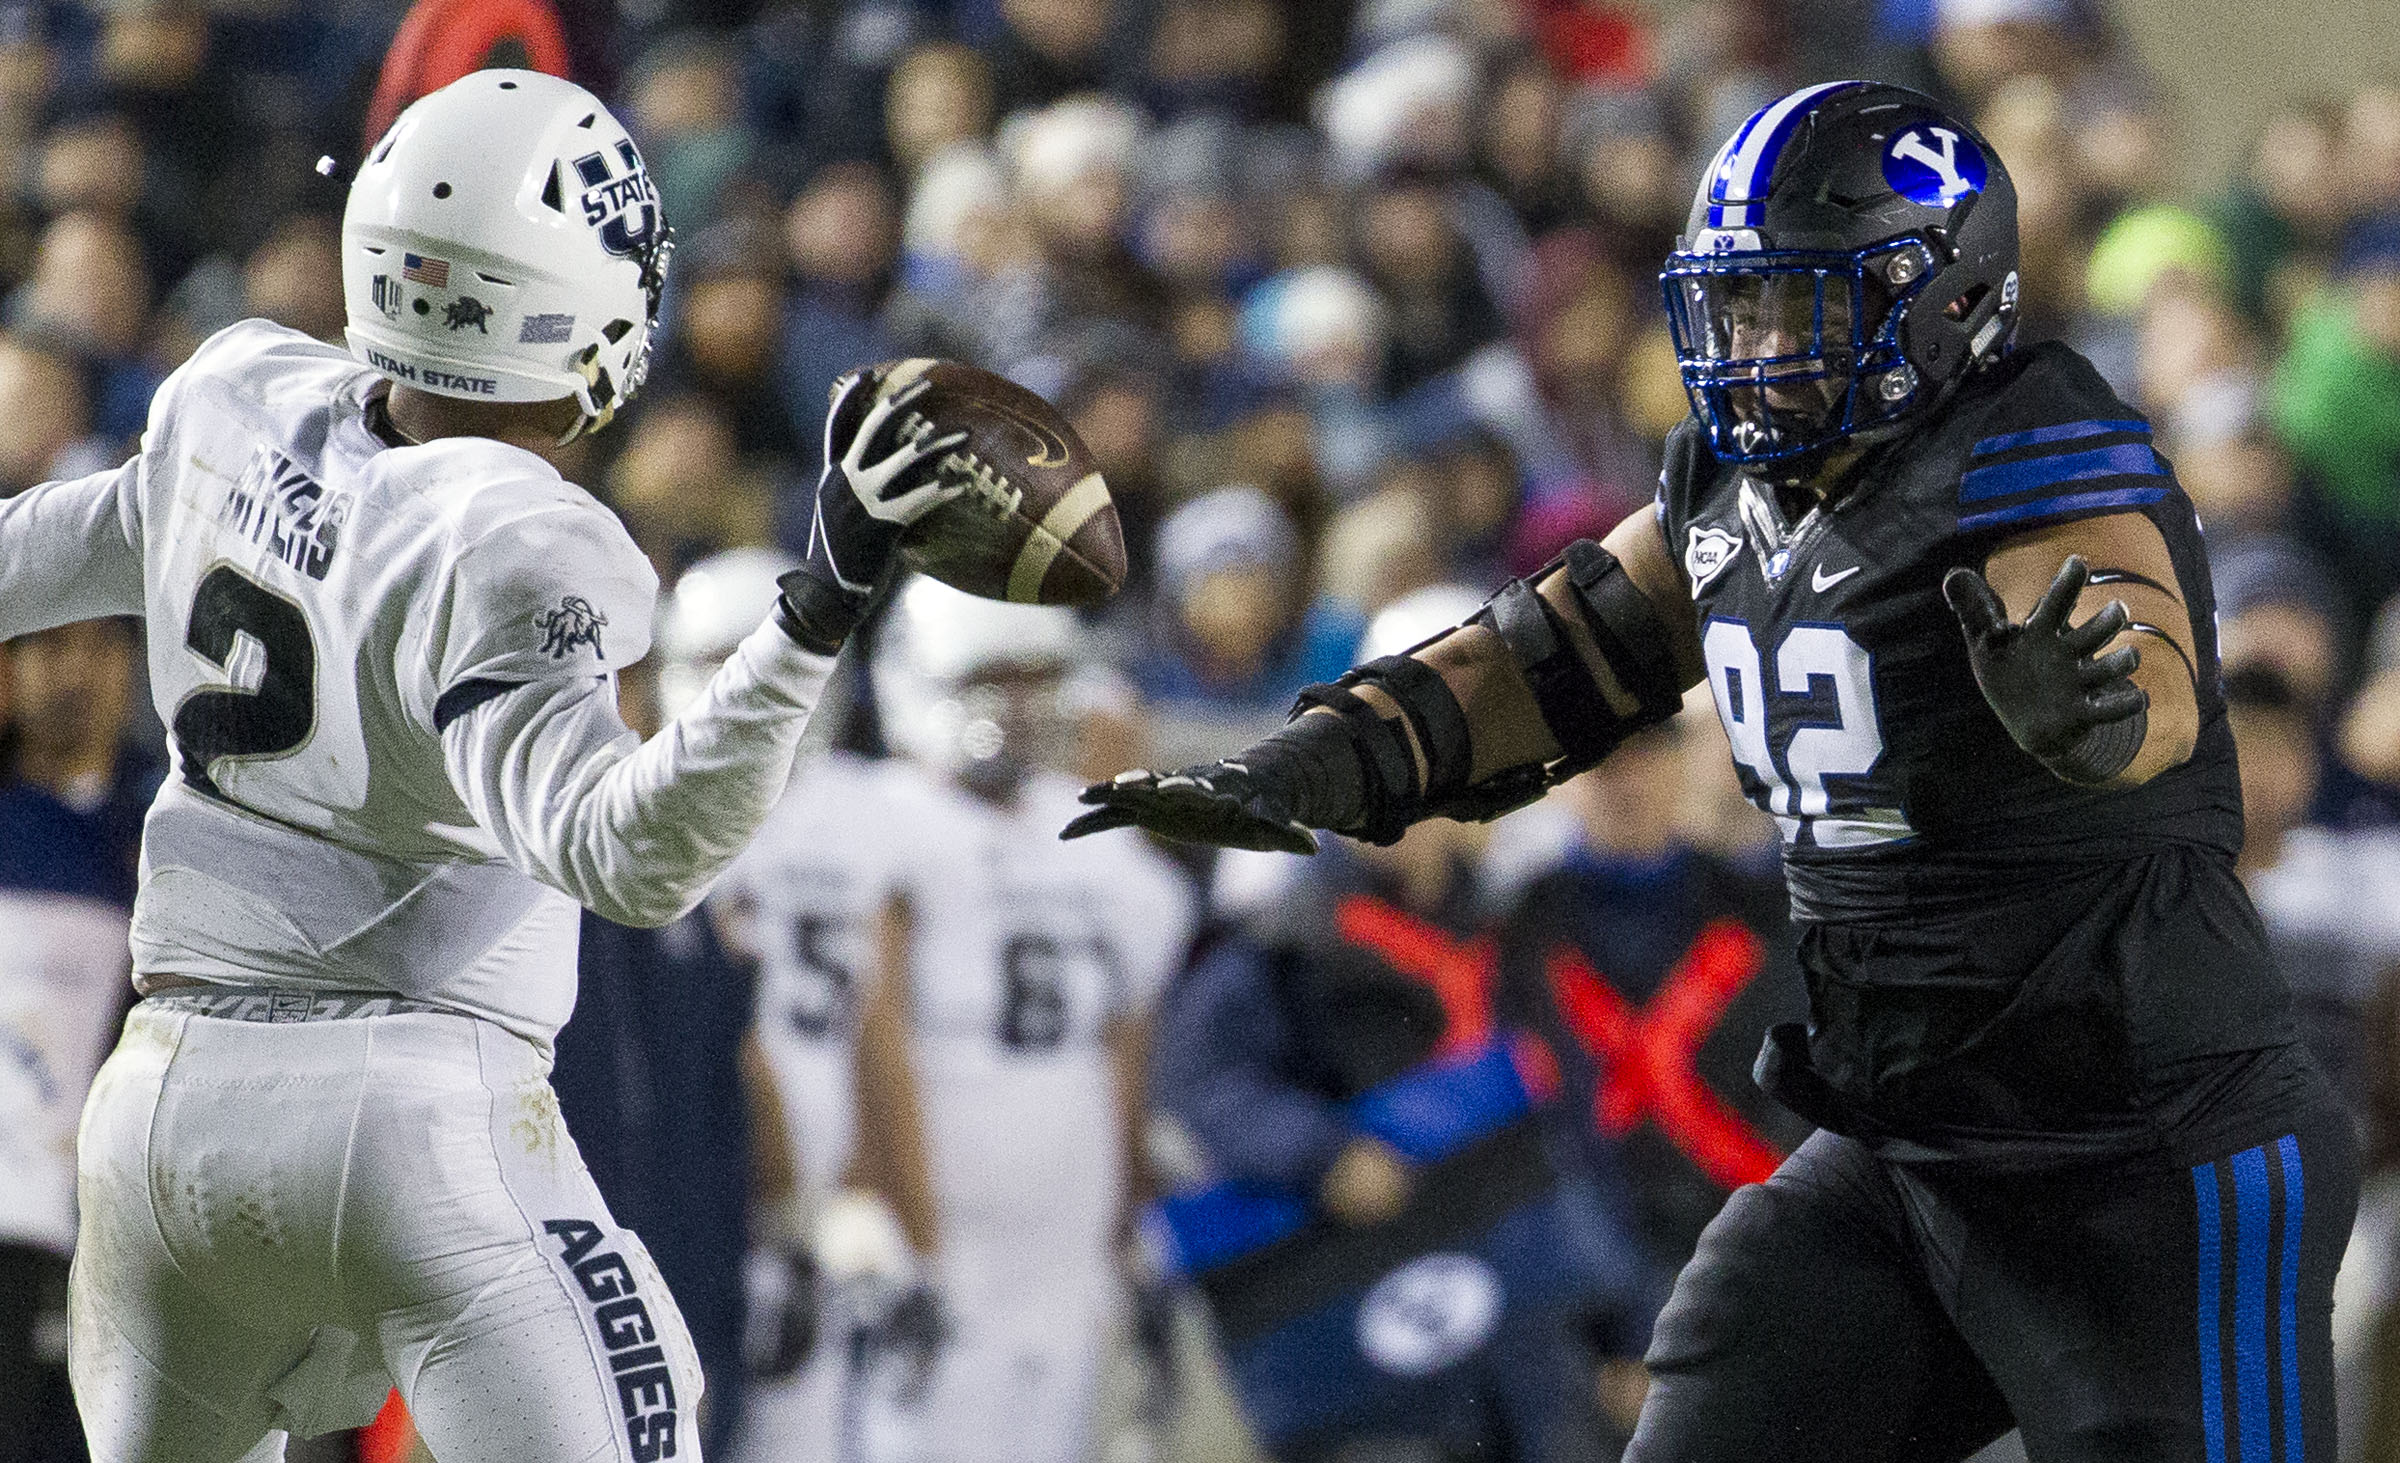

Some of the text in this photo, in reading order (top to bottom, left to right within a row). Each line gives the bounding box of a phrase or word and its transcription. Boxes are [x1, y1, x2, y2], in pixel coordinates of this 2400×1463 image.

[581, 171, 656, 227] STATE
[1890, 126, 1971, 197] Y
[366, 349, 497, 395] UTAH STATE
[172, 557, 320, 806] 2
[1703, 617, 1915, 848] 92
[542, 1218, 678, 1463] AGGIES
